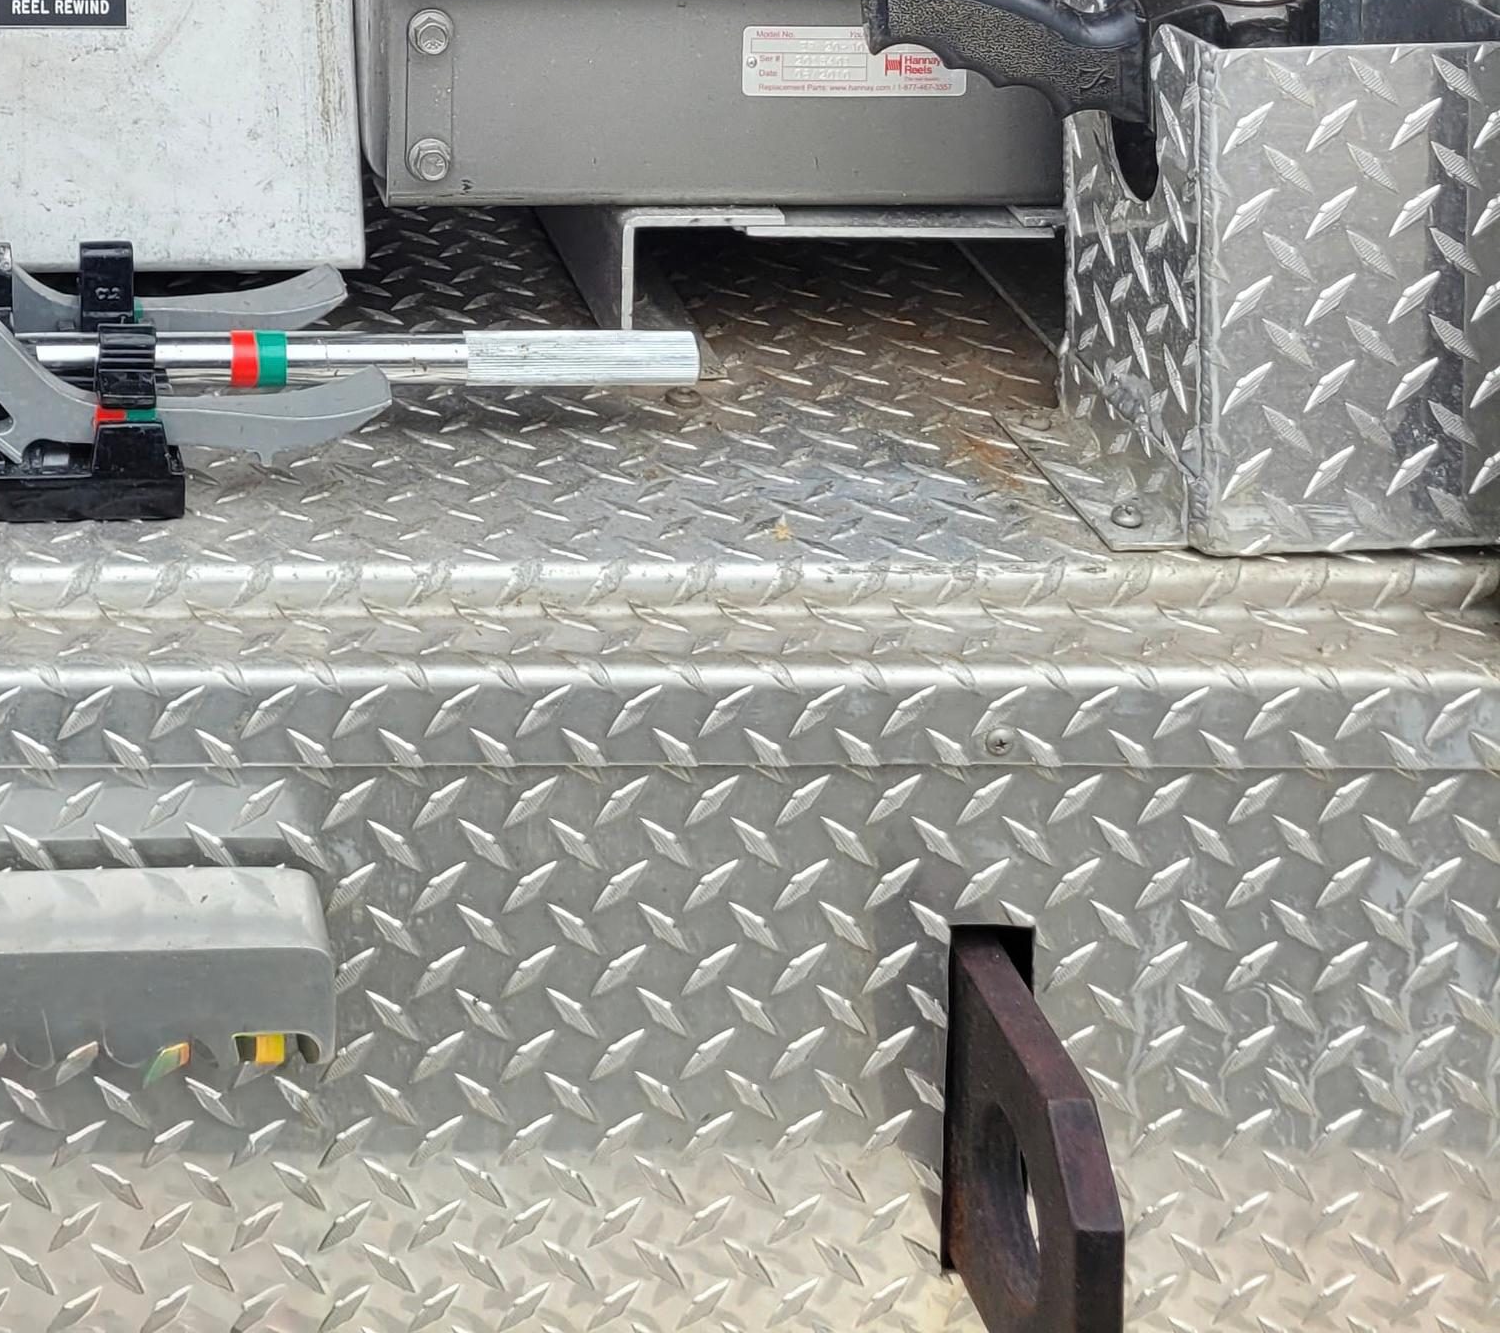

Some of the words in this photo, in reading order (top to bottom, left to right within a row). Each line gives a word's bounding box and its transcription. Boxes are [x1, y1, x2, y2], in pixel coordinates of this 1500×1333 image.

[11, 0, 49, 15] REEL
[54, 0, 110, 15] REWIND
[756, 30, 780, 38] Model
[904, 56, 941, 67] Hannay
[904, 65, 933, 74] Reels
[758, 84, 805, 92] Replacement
[829, 84, 891, 92] www.hannay.com
